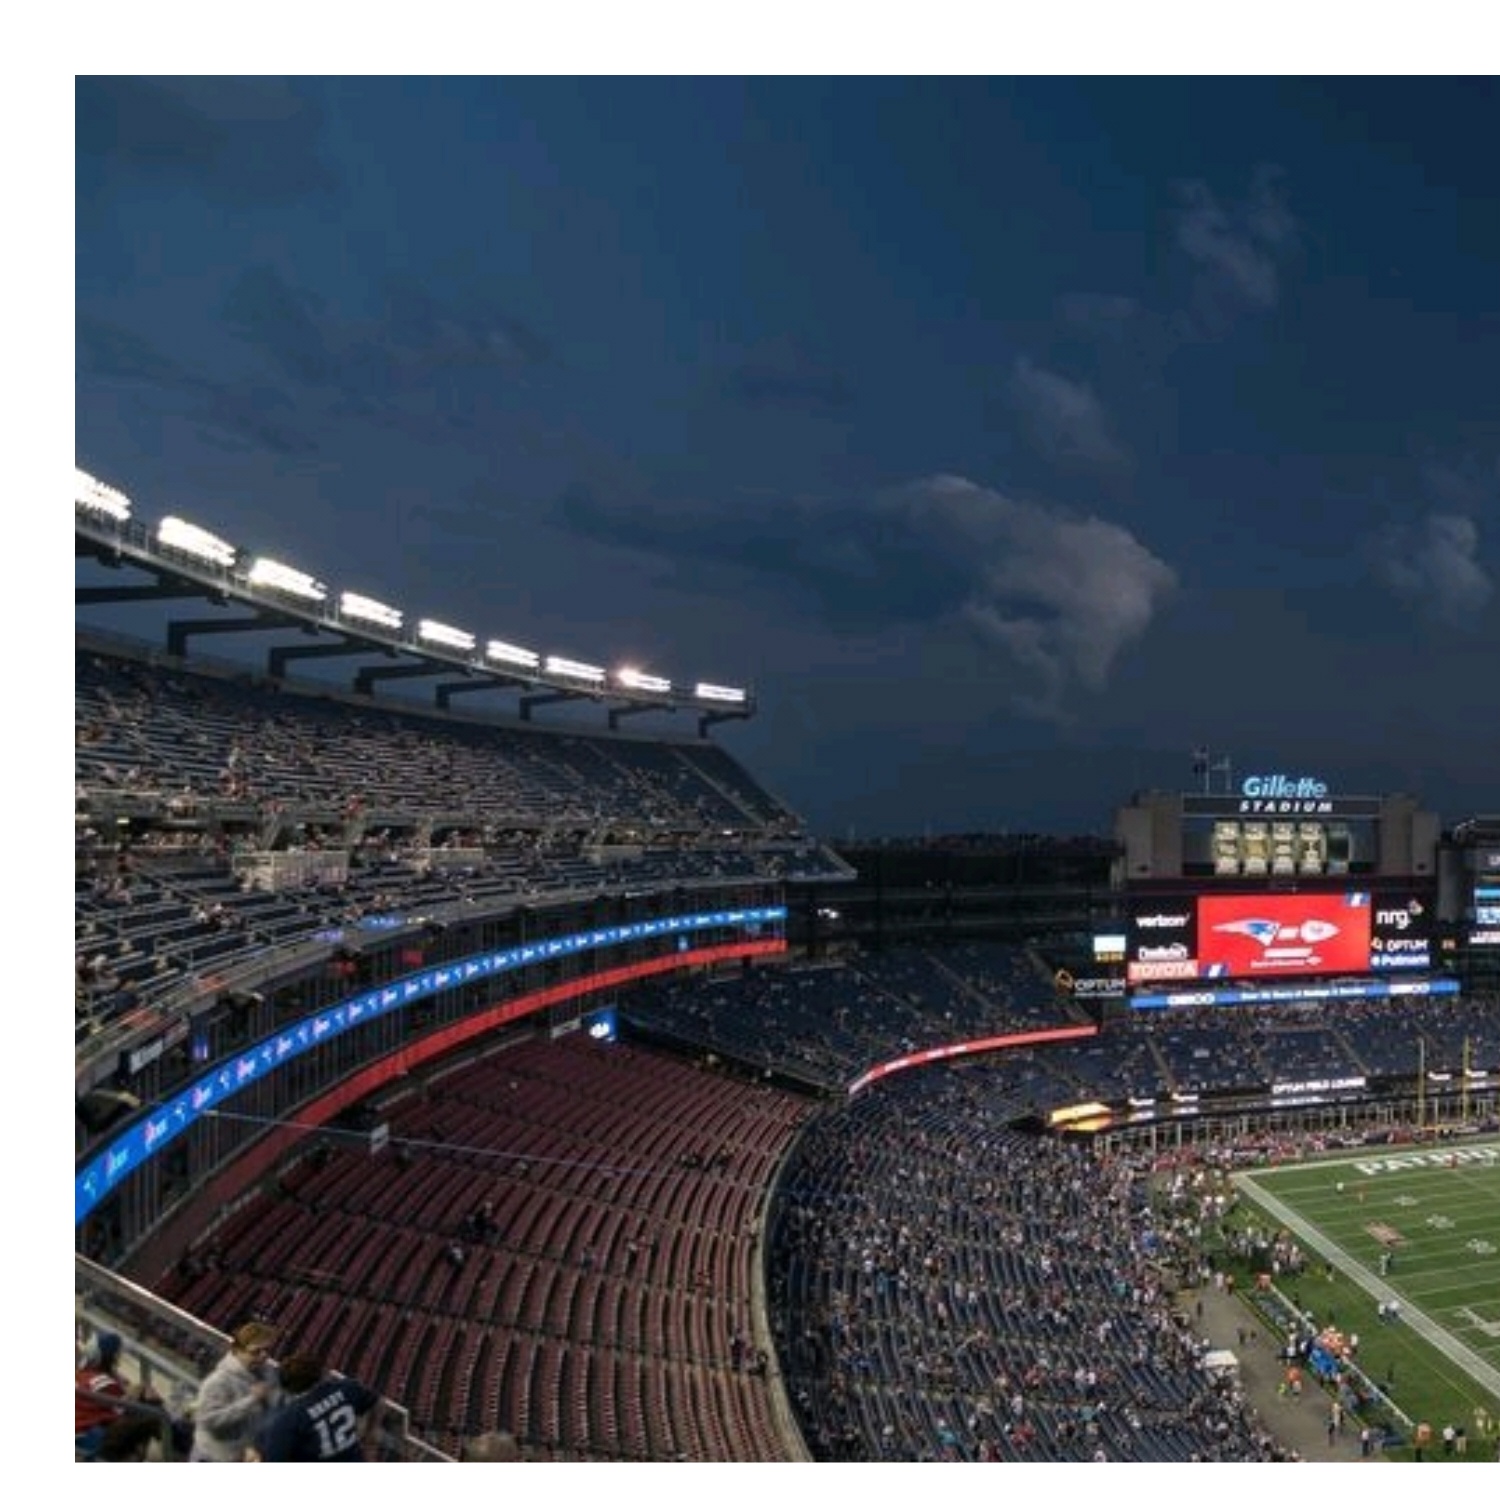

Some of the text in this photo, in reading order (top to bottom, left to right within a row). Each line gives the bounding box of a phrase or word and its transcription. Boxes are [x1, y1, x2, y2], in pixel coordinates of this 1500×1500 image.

[1242, 775, 1327, 798] Gillette
[1239, 800, 1333, 812] STADIUM
[1376, 909, 1412, 930] nrg
[313, 1403, 358, 1458] 12
